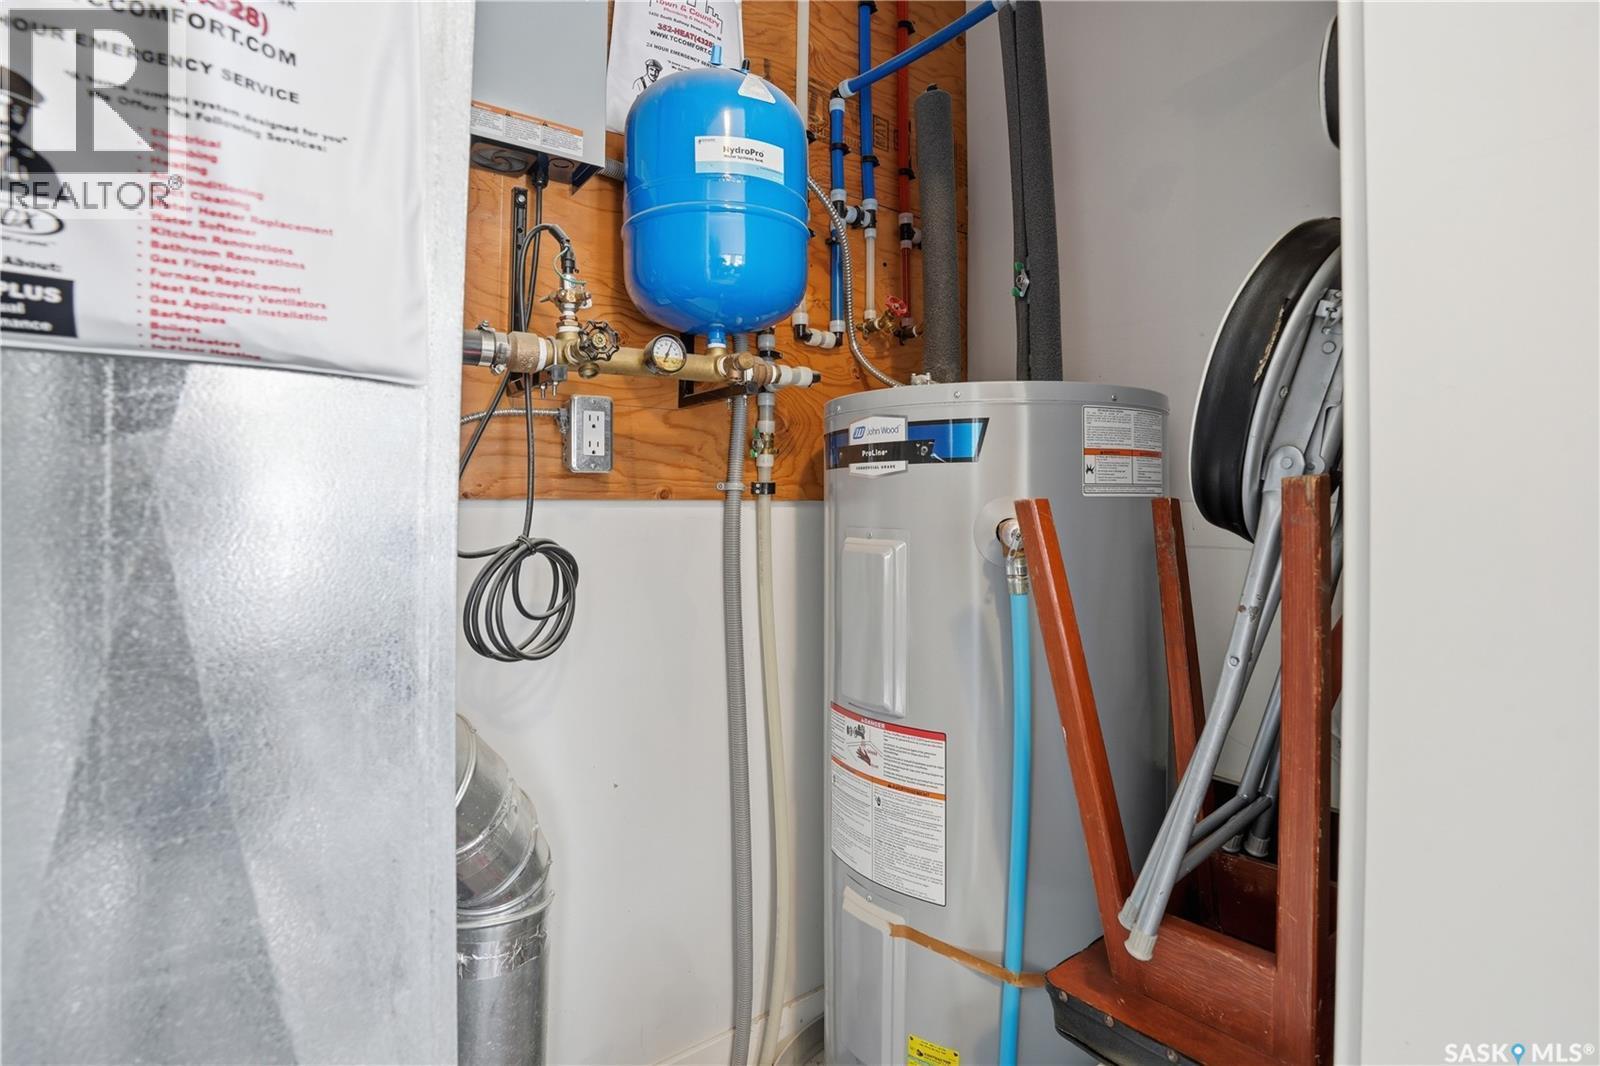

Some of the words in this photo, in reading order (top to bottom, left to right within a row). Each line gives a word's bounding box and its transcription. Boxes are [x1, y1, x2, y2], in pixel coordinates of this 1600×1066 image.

[689, 8, 720, 28] Country
[650, 29, 712, 56] WWW.TCCOMFORT.C
[653, 43, 669, 53] HOUR
[670, 49, 700, 64] EMERGENCY
[221, 68, 300, 104] SERVICE
[193, 98, 239, 117] system
[244, 113, 299, 134] designed
[303, 127, 318, 138] for
[151, 127, 221, 149] Electrical
[195, 111, 262, 139] Following
[266, 132, 328, 152] Services:
[722, 146, 764, 158] HydroPro
[151, 156, 208, 176] Heating
[189, 191, 251, 211] Cleaning
[151, 212, 193, 226] Water
[199, 219, 257, 236] Softener
[199, 206, 245, 222] Heater
[250, 215, 334, 237] Replacement
[151, 226, 207, 243] Kitchen
[212, 235, 294, 256] Renovations
[150, 254, 178, 266] Gas
[184, 258, 256, 277] Fireplaces
[151, 240, 221, 258] Bathroom
[226, 250, 306, 271] Renovations
[150, 267, 209, 283] Furnace
[215, 275, 302, 295] Replacement
[150, 281, 184, 294] Heat
[190, 286, 254, 304] Recovery
[258, 294, 327, 310] Ventilators
[150, 295, 178, 306] Gas
[184, 299, 252, 316] Appliance
[257, 308, 329, 322] Installation
[150, 309, 226, 325] Barbeques
[150, 322, 202, 335] Boilers
[151, 333, 182, 343] Pool
[186, 337, 241, 349] Heaters
[866, 427, 880, 436] John
[881, 425, 900, 434] Wood
